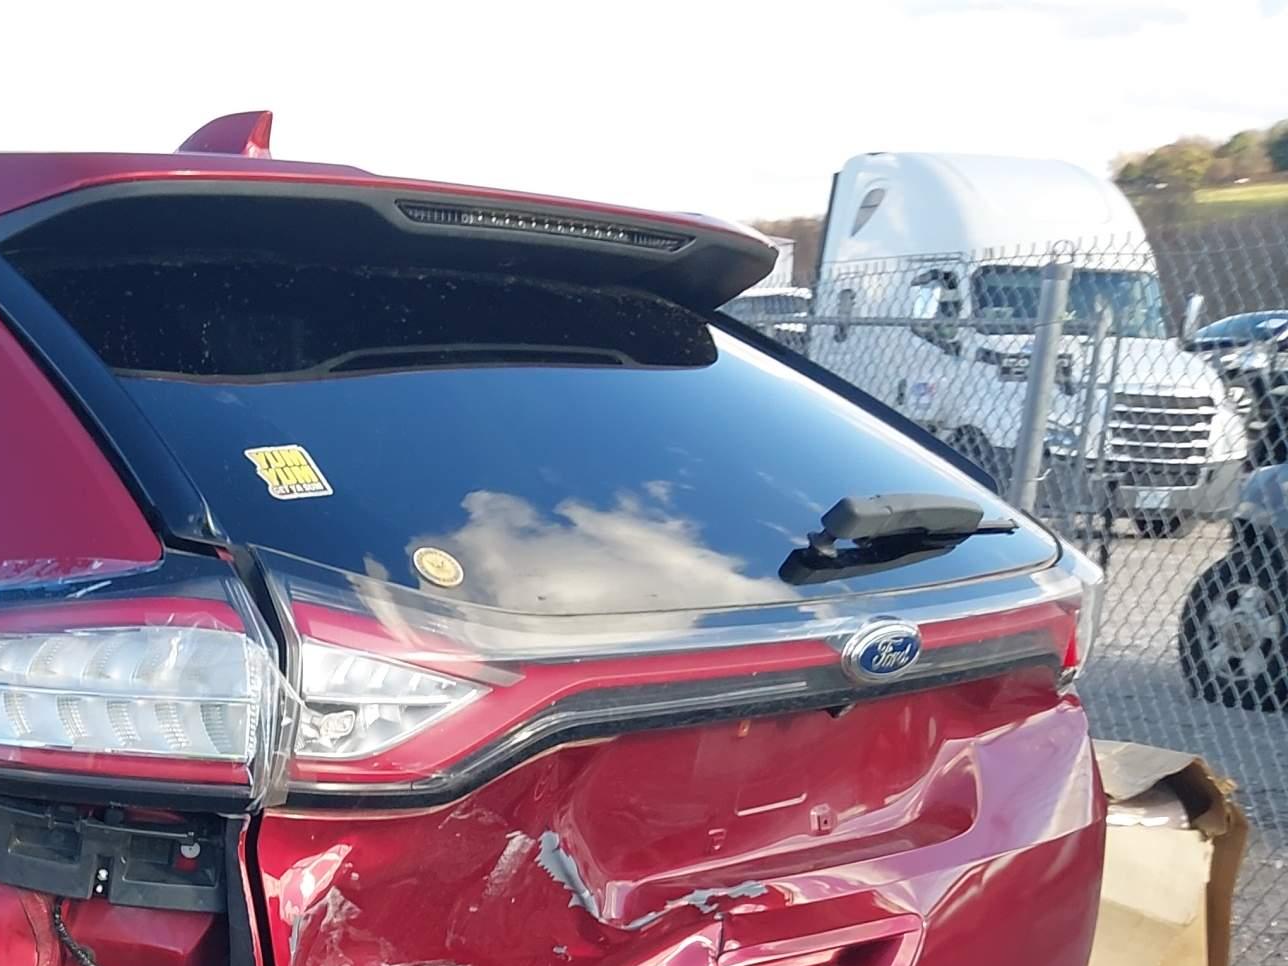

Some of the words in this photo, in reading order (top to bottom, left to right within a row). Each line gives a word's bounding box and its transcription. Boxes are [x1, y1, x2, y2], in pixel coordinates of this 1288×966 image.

[251, 450, 308, 469] YUM
[263, 466, 319, 486] YUM
[872, 636, 912, 671] Ford
